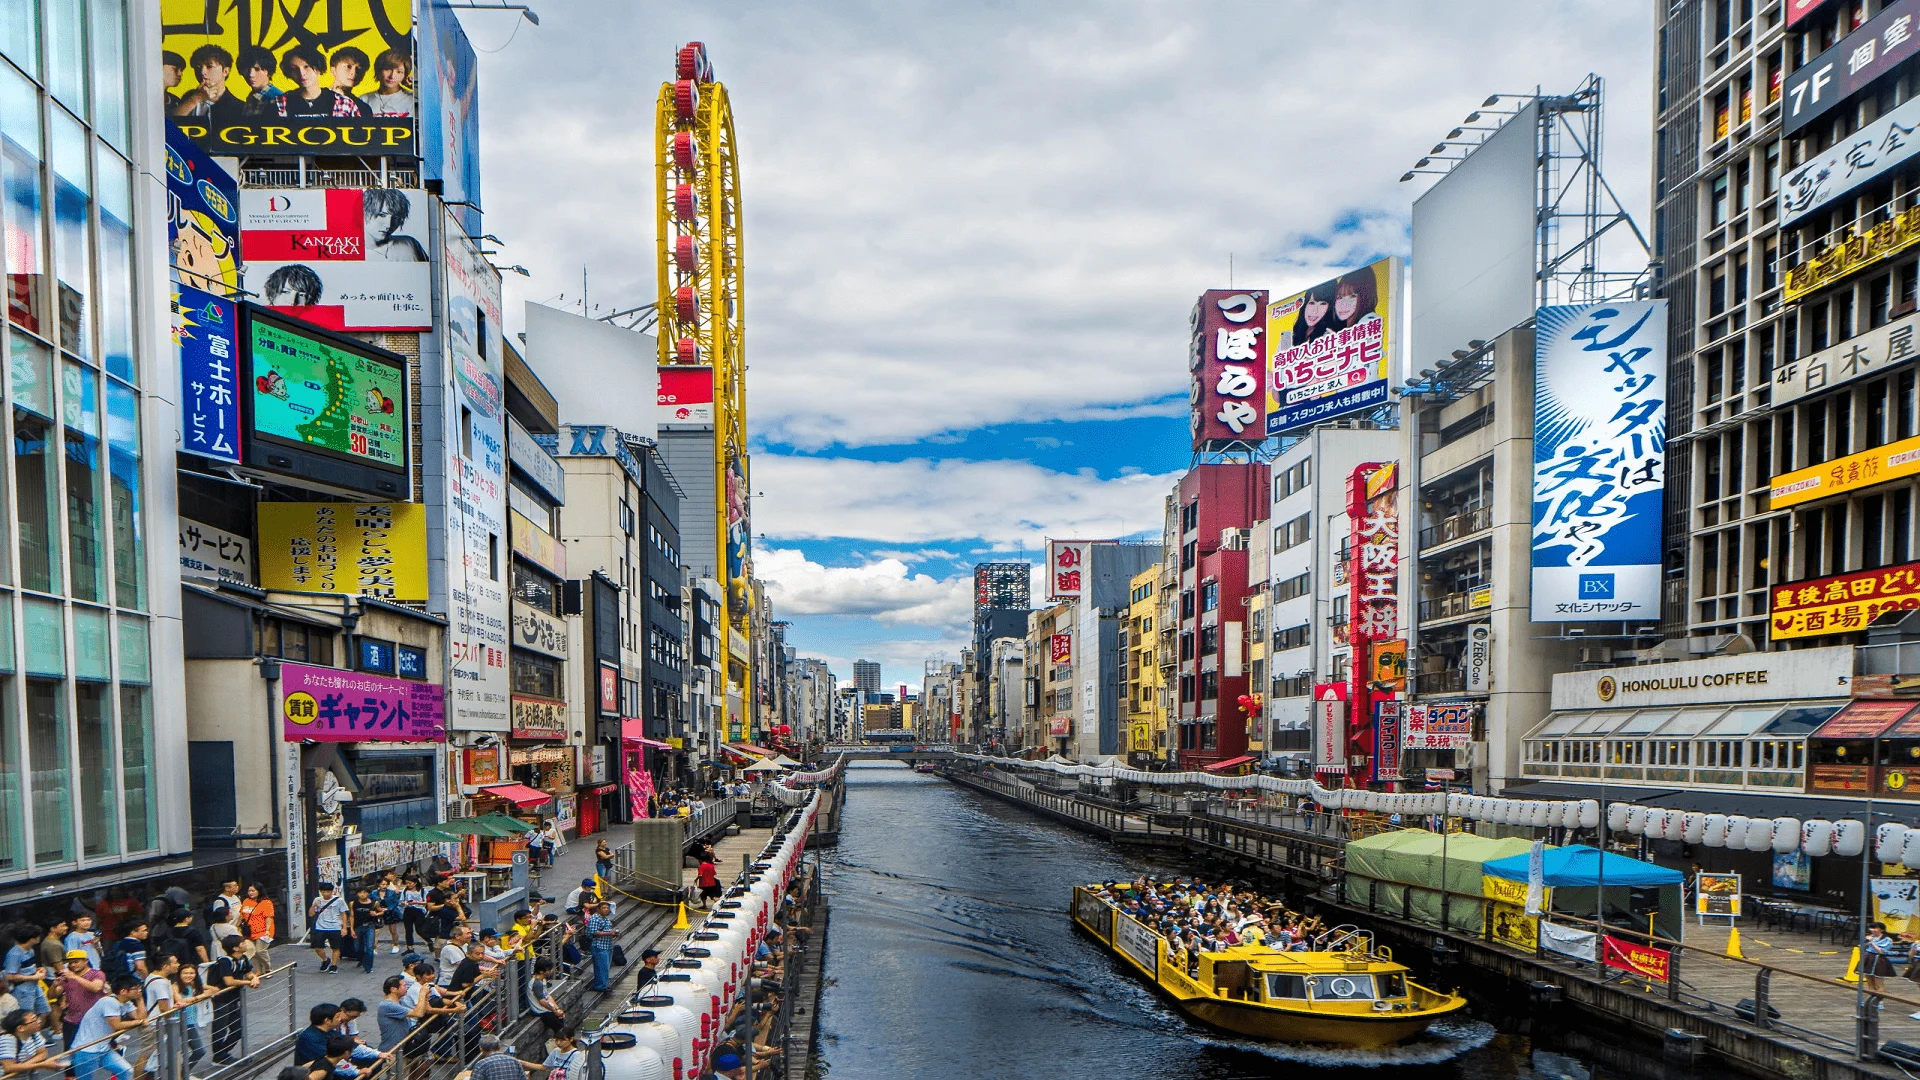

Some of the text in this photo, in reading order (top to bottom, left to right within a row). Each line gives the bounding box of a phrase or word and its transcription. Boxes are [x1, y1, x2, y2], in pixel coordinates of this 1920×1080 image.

[1790, 62, 1833, 117] 7F
[219, 126, 412, 146] GROUP
[291, 234, 360, 250] KANZAKI
[318, 245, 361, 258] RUKA
[1274, 318, 1382, 370] 高収入お仕事情報
[1806, 325, 1915, 392] 白木屋
[1217, 291, 1263, 434] づぼらや
[1274, 341, 1381, 390] いちごナビ
[1777, 364, 1797, 385] 4F
[207, 334, 234, 455] 富士ホーム
[1269, 386, 1385, 428] 店舗・スタッフ求人も掲載中!
[1289, 382, 1325, 402] いちごナビ
[190, 381, 207, 444] サービス
[350, 433, 367, 455] 30
[1829, 456, 1879, 488] 鳥貴族
[290, 537, 312, 584] 応援します
[316, 507, 337, 590] あなたのお店づくり
[1359, 510, 1398, 638] 大阪王将
[1583, 579, 1610, 593] BX
[1796, 605, 1863, 632] 酒場
[1622, 670, 1768, 692] HONOLULU COFFEE
[289, 698, 315, 718] 賃貸
[319, 693, 411, 731] ギャラント
[1428, 708, 1468, 724] ダイコク
[1383, 717, 1396, 749] ダイコク
[1425, 735, 1451, 747] 免税
